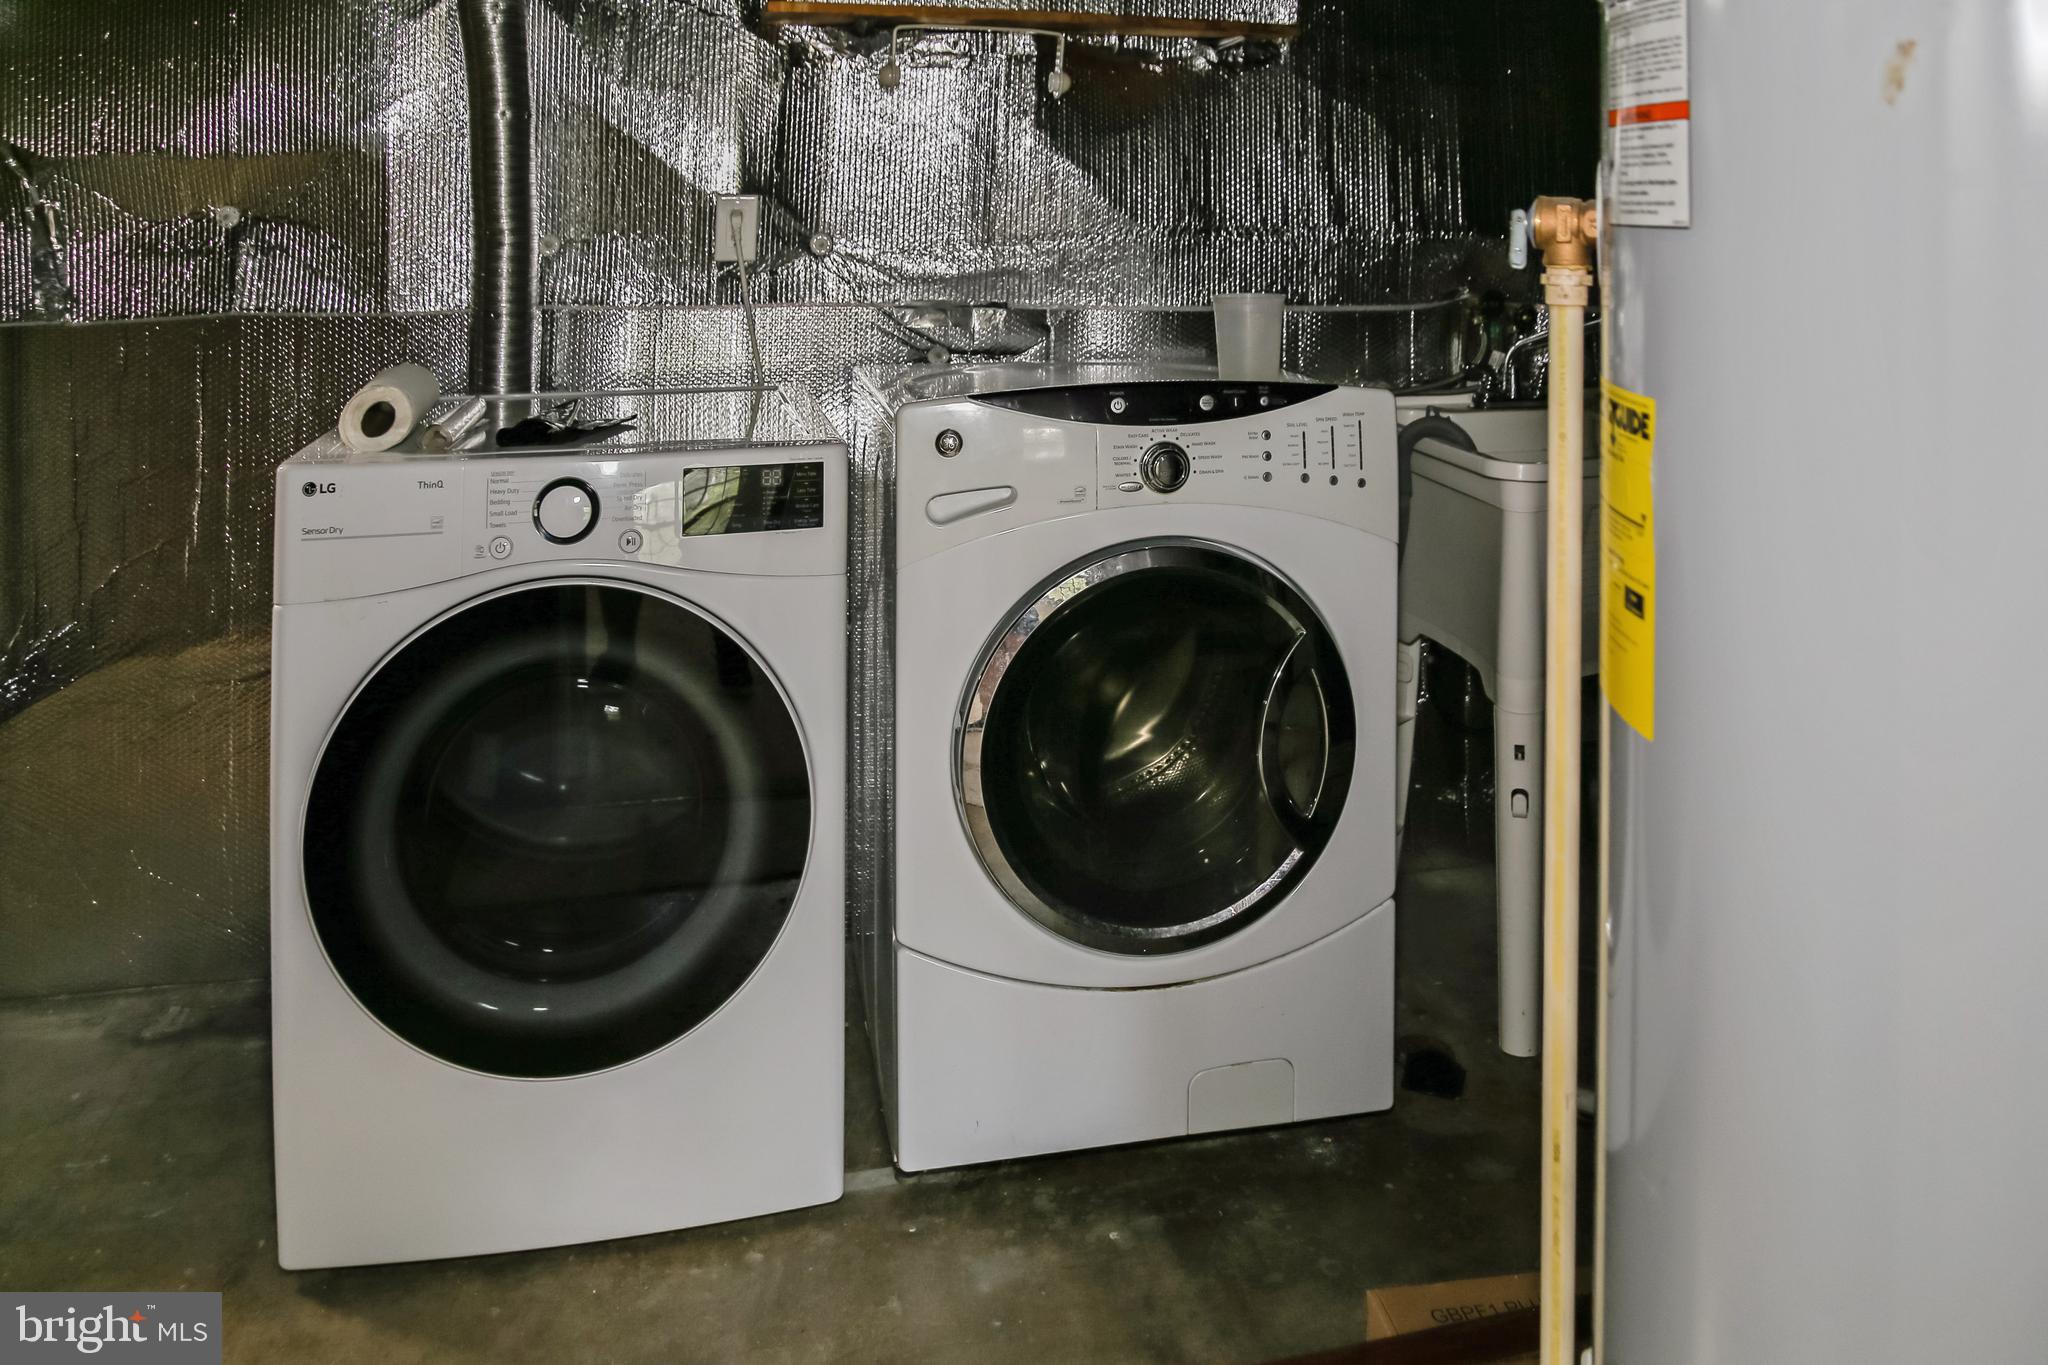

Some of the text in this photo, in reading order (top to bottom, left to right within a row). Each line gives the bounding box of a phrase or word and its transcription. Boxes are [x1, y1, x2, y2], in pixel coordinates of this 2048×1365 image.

[319, 482, 336, 494] LG
[417, 480, 444, 489] ThinQ
[506, 487, 520, 495] Duty
